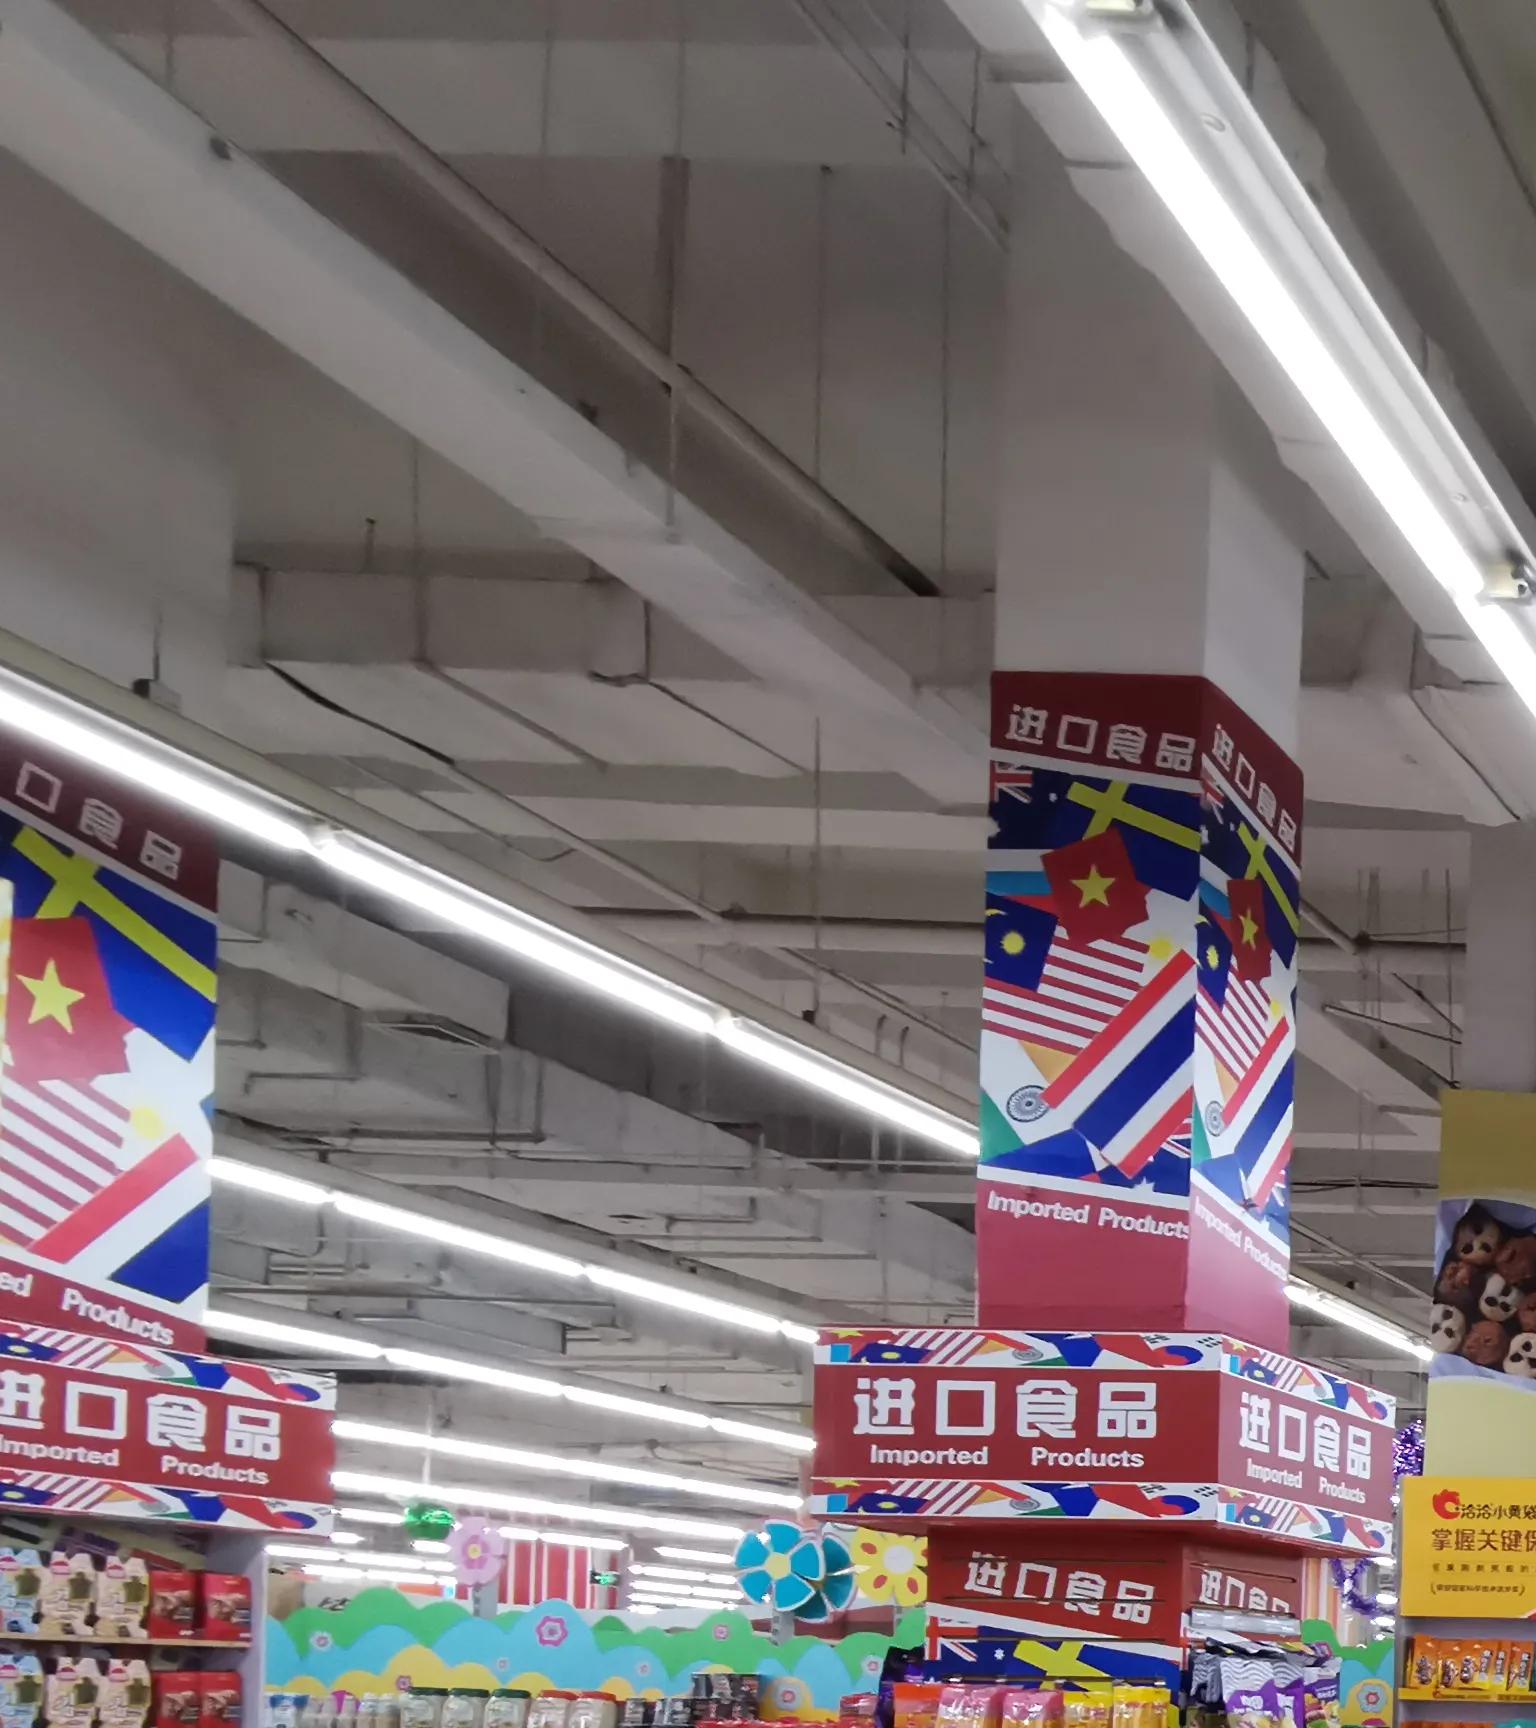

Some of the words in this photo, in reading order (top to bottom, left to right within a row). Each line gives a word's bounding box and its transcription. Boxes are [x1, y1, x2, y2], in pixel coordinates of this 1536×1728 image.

[1005, 704, 1196, 772] 进口食品
[1212, 723, 1297, 854] 进口食品
[987, 1190, 1089, 1224] Imported
[62, 1288, 174, 1346] Products
[852, 1377, 1157, 1439] 进口食品
[1239, 1391, 1371, 1480] 进口食品
[161, 1454, 270, 1485] Products
[870, 1444, 988, 1469] Imported
[1031, 1445, 1144, 1468] Products
[1246, 1457, 1302, 1489] Imported
[1318, 1475, 1366, 1504] Products
[964, 1551, 1155, 1624] 进口食品
